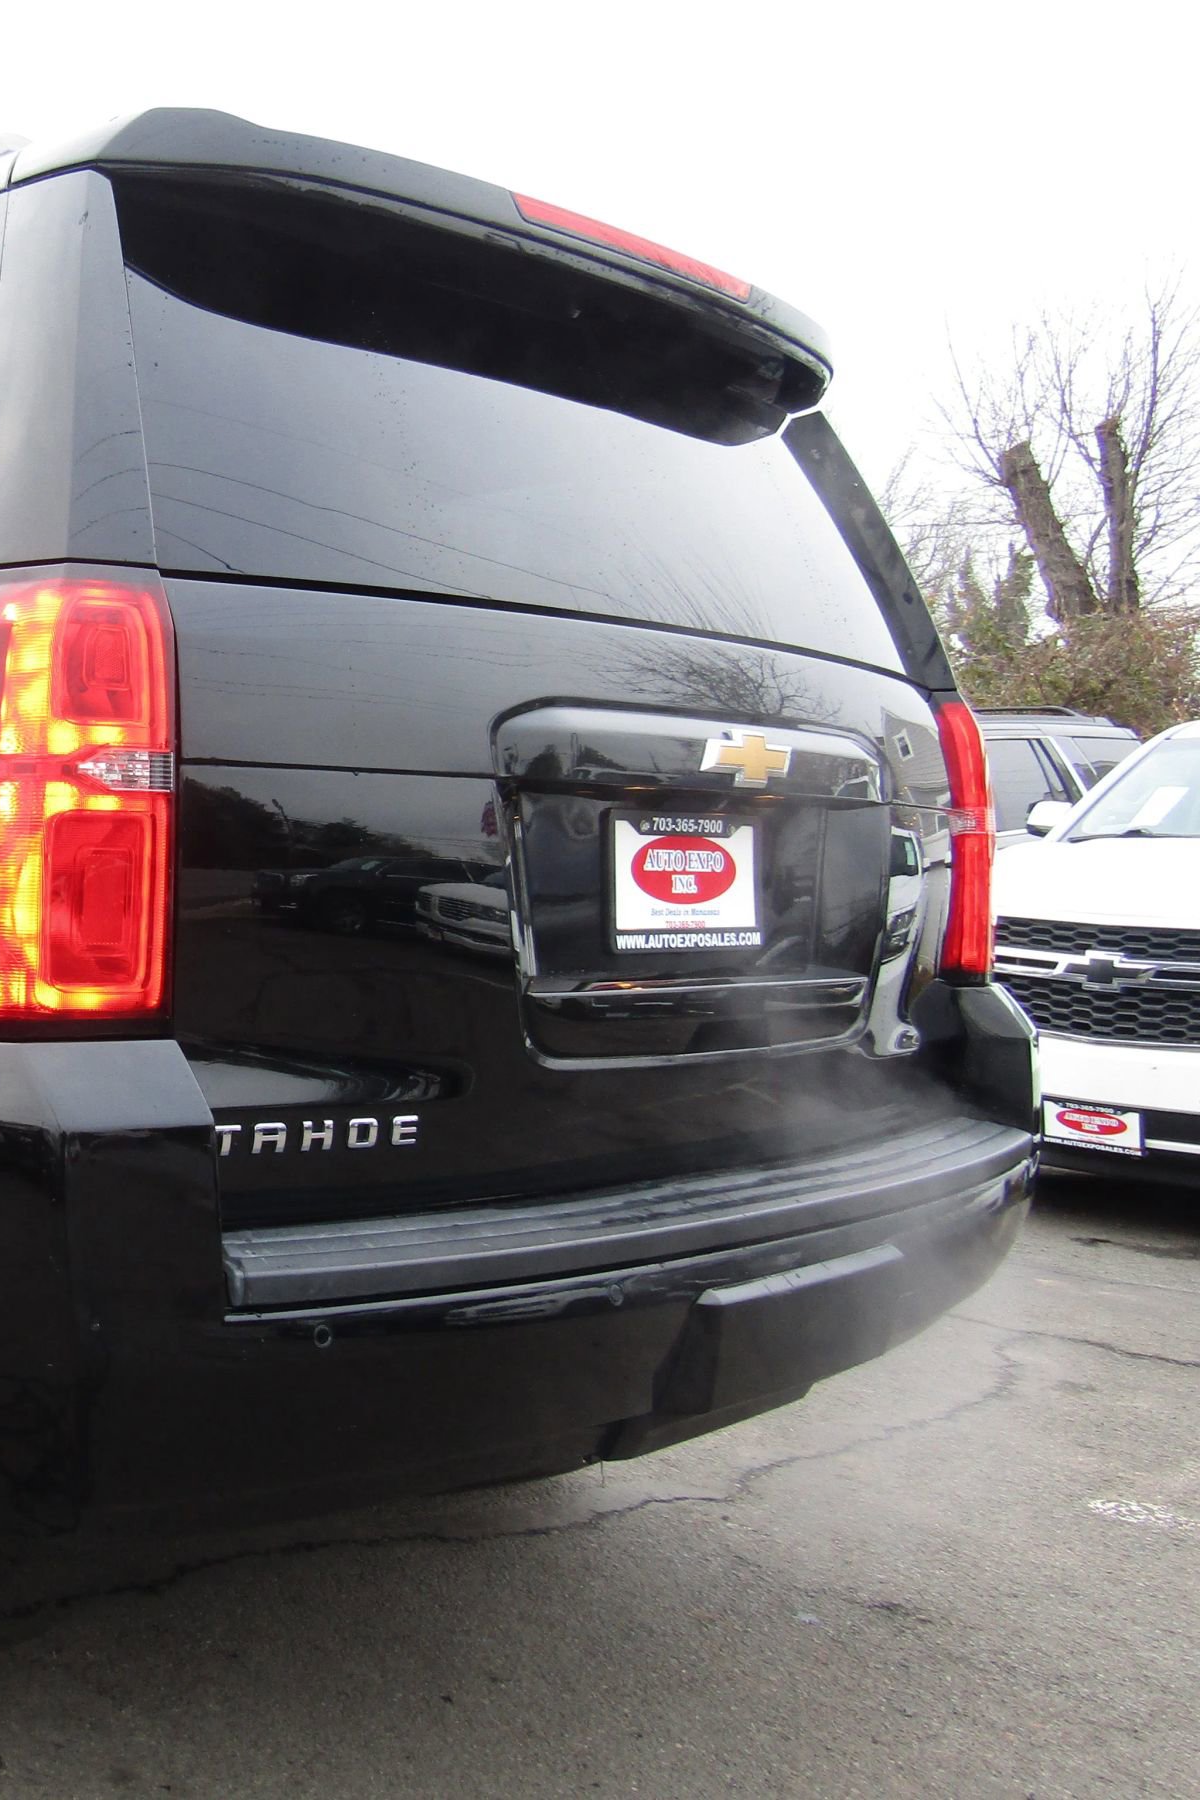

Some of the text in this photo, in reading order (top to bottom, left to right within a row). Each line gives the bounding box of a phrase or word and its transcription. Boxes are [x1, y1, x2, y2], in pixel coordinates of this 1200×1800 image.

[652, 817, 723, 833] 703-365-7900
[644, 849, 724, 872] AUTO EXPO
[672, 875, 698, 893] INC.
[616, 932, 761, 949] WWW.AUTOEXPOSALES.COM
[215, 1115, 419, 1156] TAHOE
